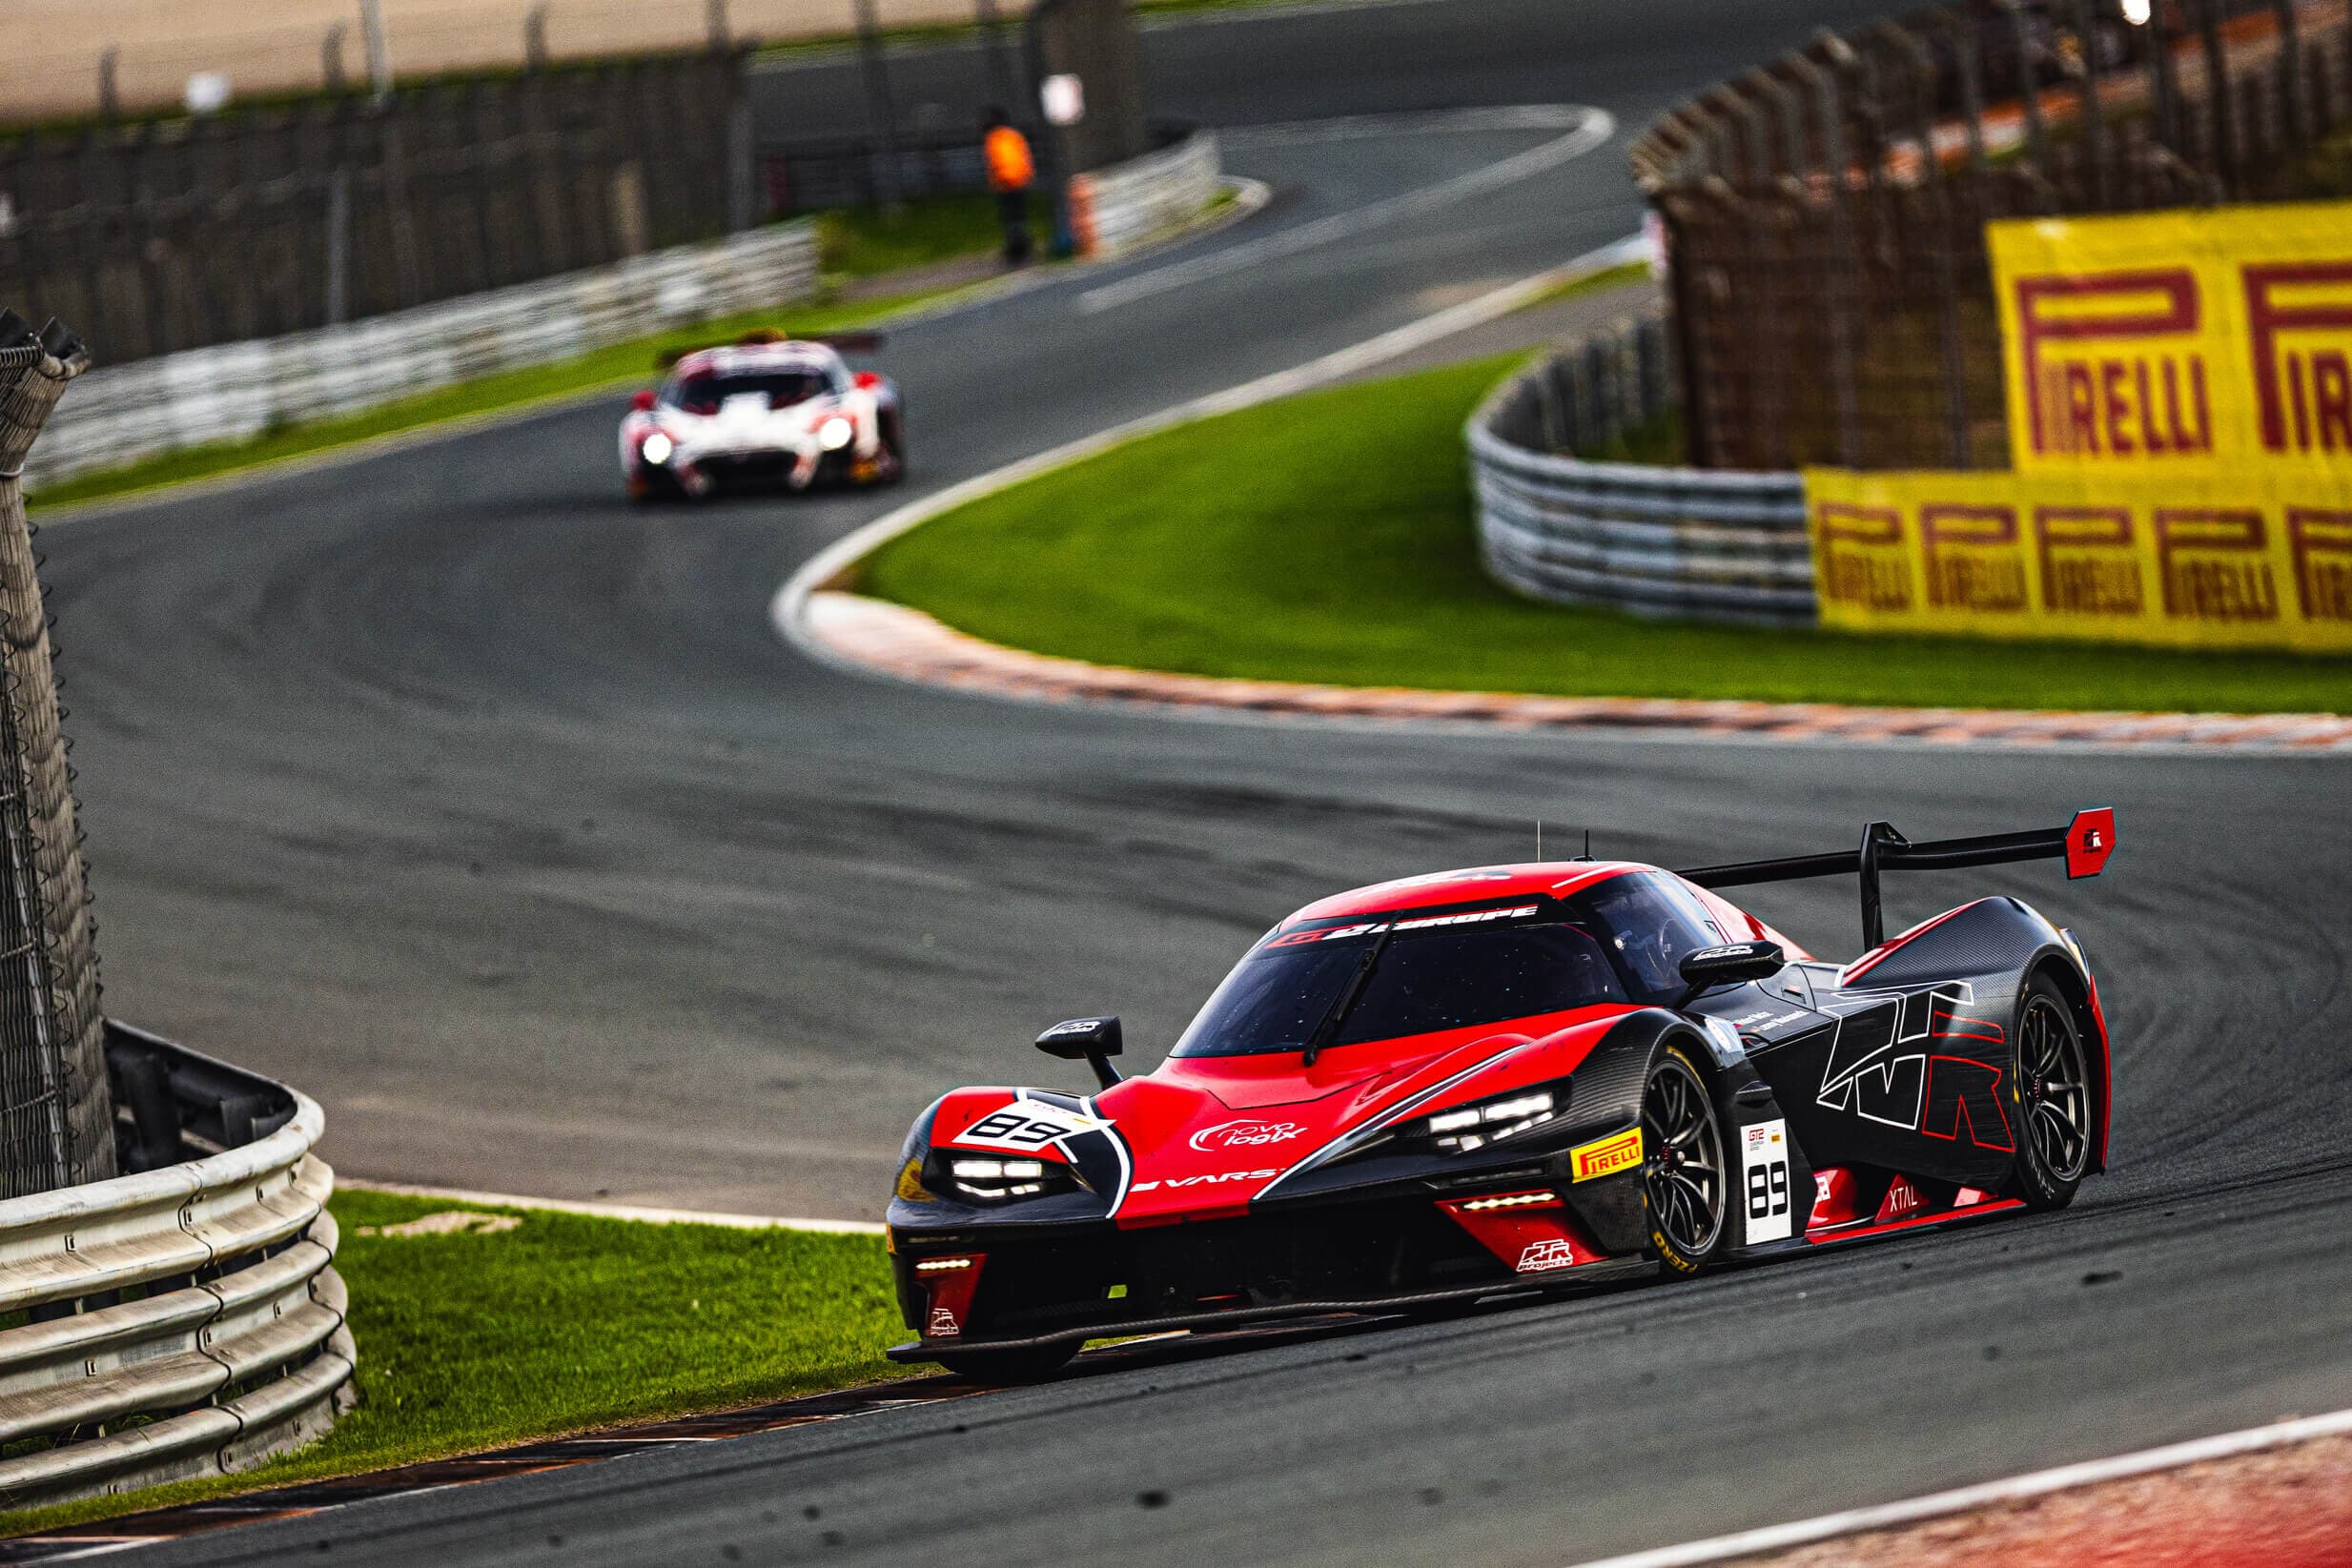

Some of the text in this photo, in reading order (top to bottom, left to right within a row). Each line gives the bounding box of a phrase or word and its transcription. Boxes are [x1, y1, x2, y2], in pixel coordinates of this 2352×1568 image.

[966, 1112, 1073, 1144] 89
[1217, 1122, 1296, 1138] novo
[1223, 1127, 1309, 1147] logix
[1579, 1135, 1641, 1176] PIRELLI
[1164, 1169, 1278, 1188] VARS
[1748, 1160, 1789, 1220] 89
